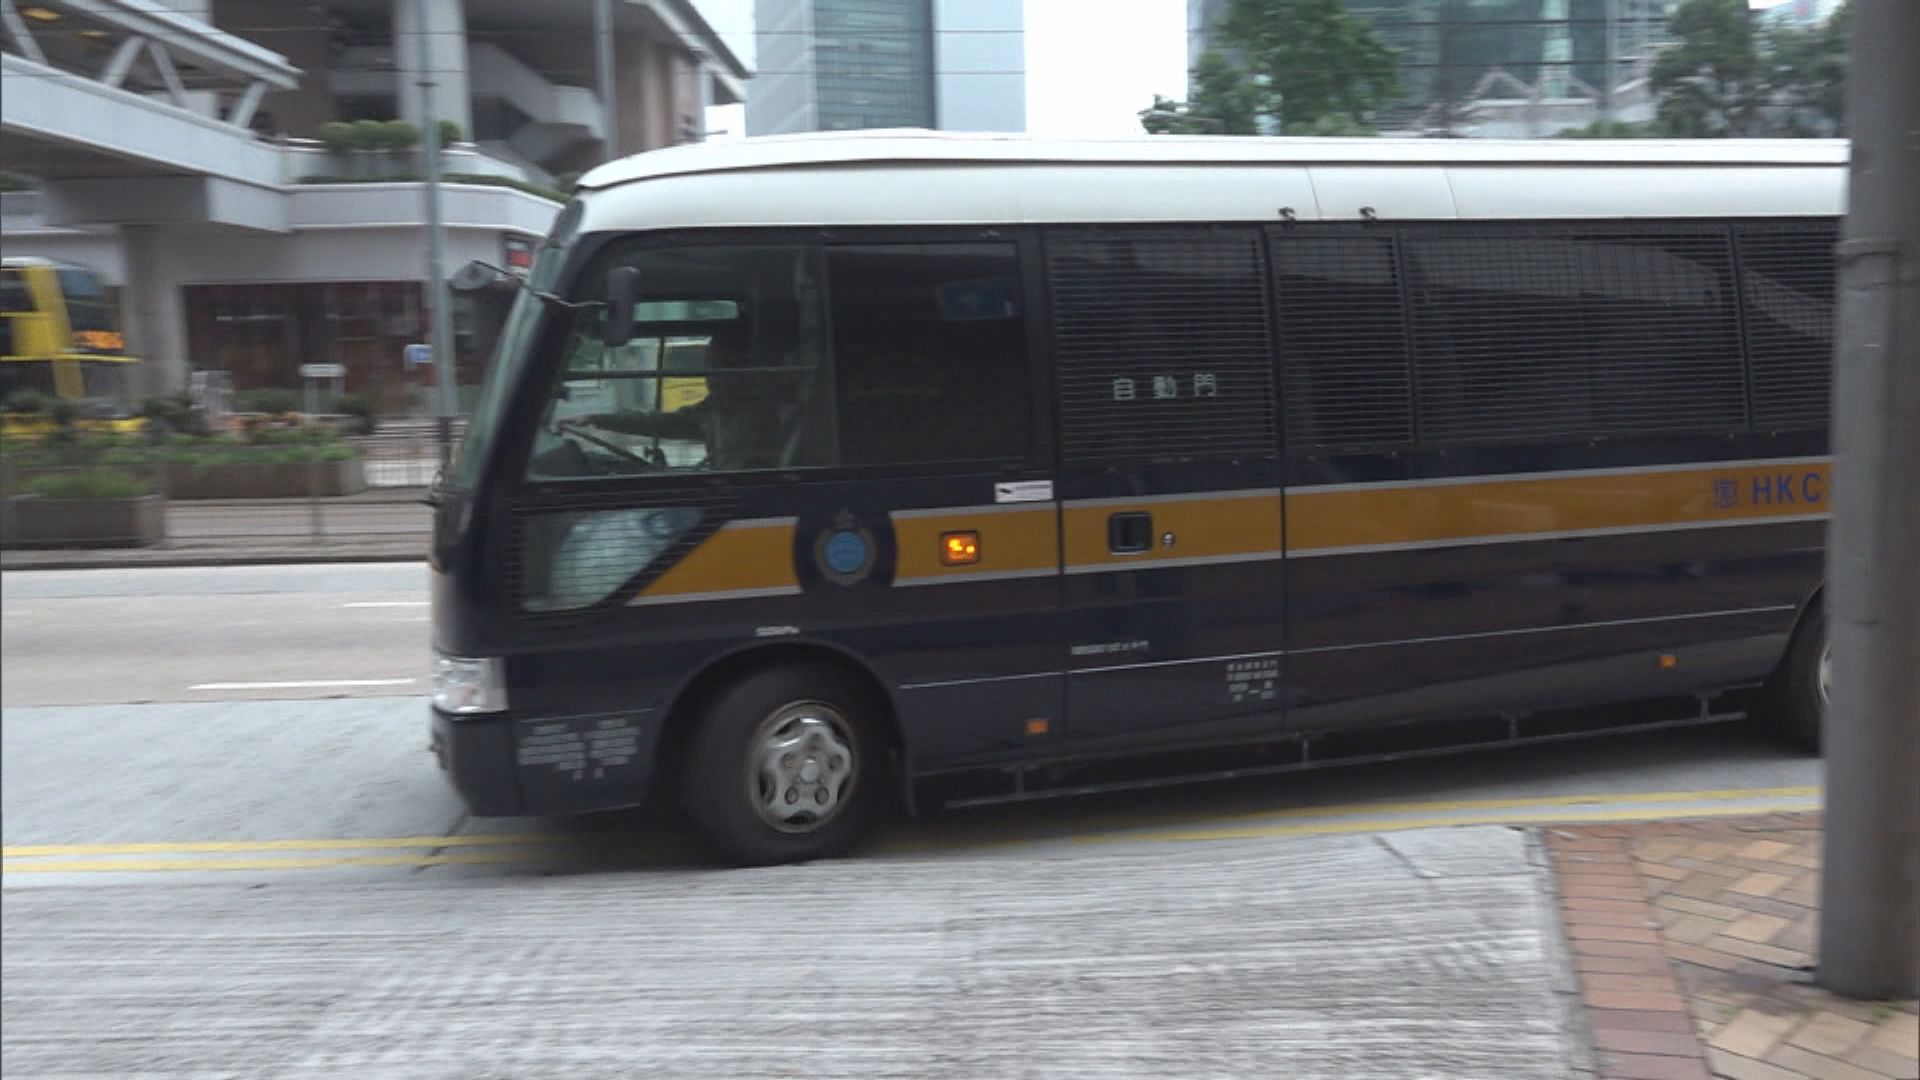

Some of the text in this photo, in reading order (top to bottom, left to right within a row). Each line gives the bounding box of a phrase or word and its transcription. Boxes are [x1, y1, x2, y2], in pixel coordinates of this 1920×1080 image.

[1112, 373, 1217, 401] 自動門
[1752, 472, 1822, 505] HKC
